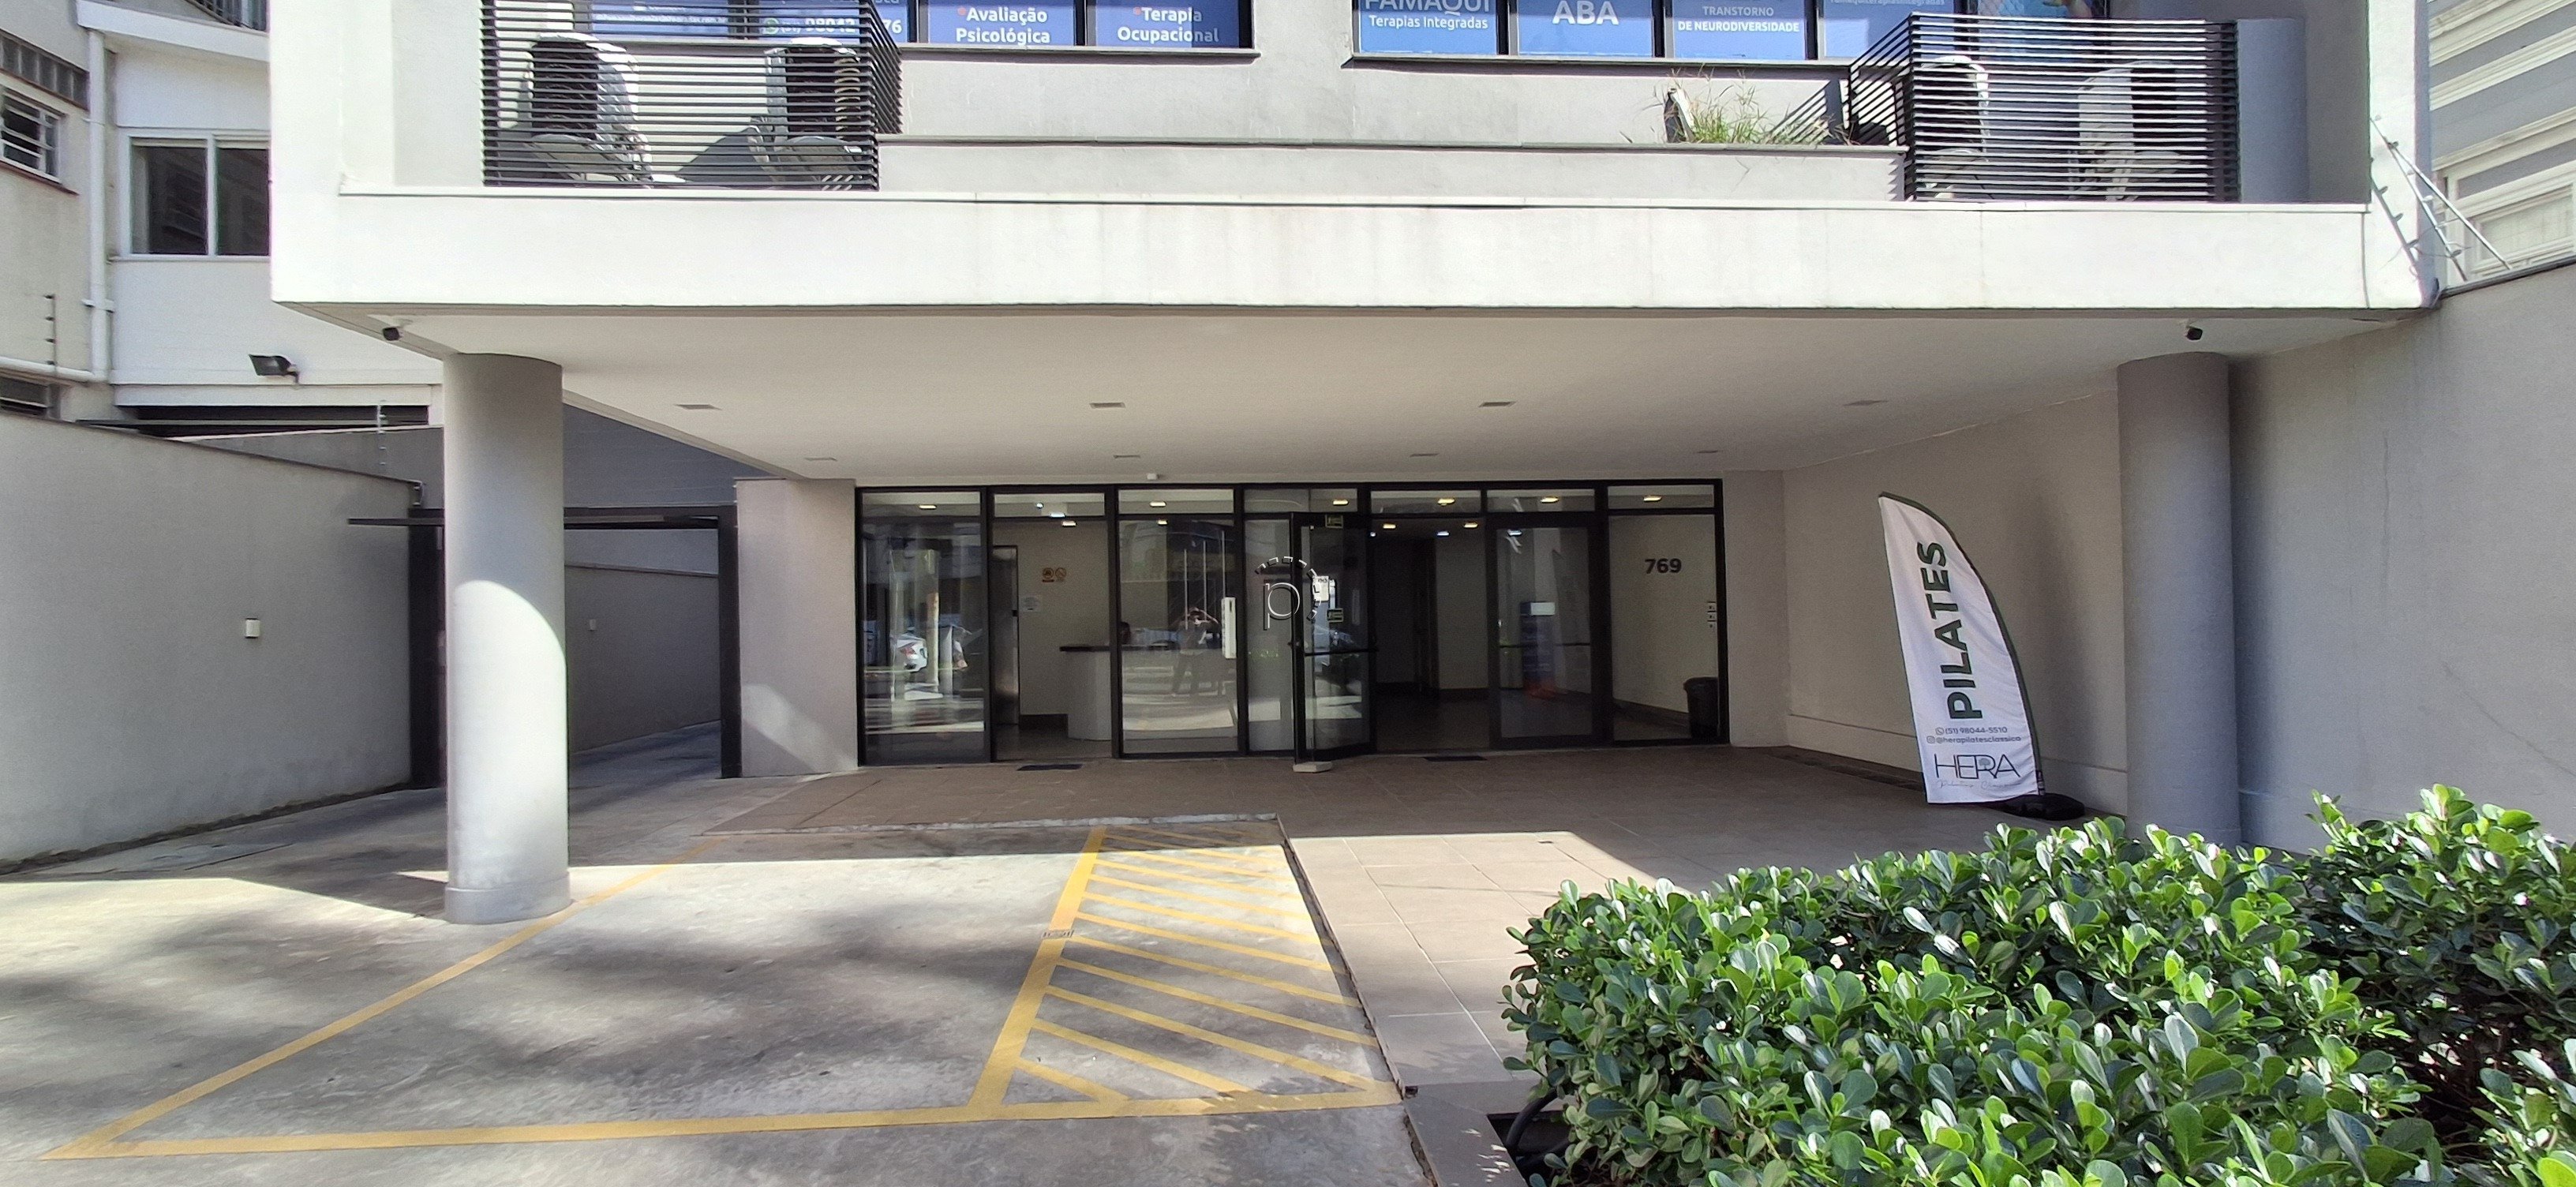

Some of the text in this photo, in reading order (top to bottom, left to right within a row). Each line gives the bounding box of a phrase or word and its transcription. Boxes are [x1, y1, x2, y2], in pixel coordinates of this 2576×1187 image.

[966, 7, 1048, 26] Avaliação
[1141, 7, 1202, 24] Terapia
[1552, 0, 1619, 25] ABA
[1702, 6, 1774, 17] TRANSTORNO
[1369, 15, 1488, 31] Terapias Integradas
[1678, 21, 1800, 32] DE NEURODIVERSIDADE
[956, 28, 1050, 46] Psicológica
[1118, 27, 1219, 44] Ocupacional
[1644, 558, 1682, 575] 769
[1915, 541, 1983, 720] PILATES
[1934, 754, 2021, 779] HERA
